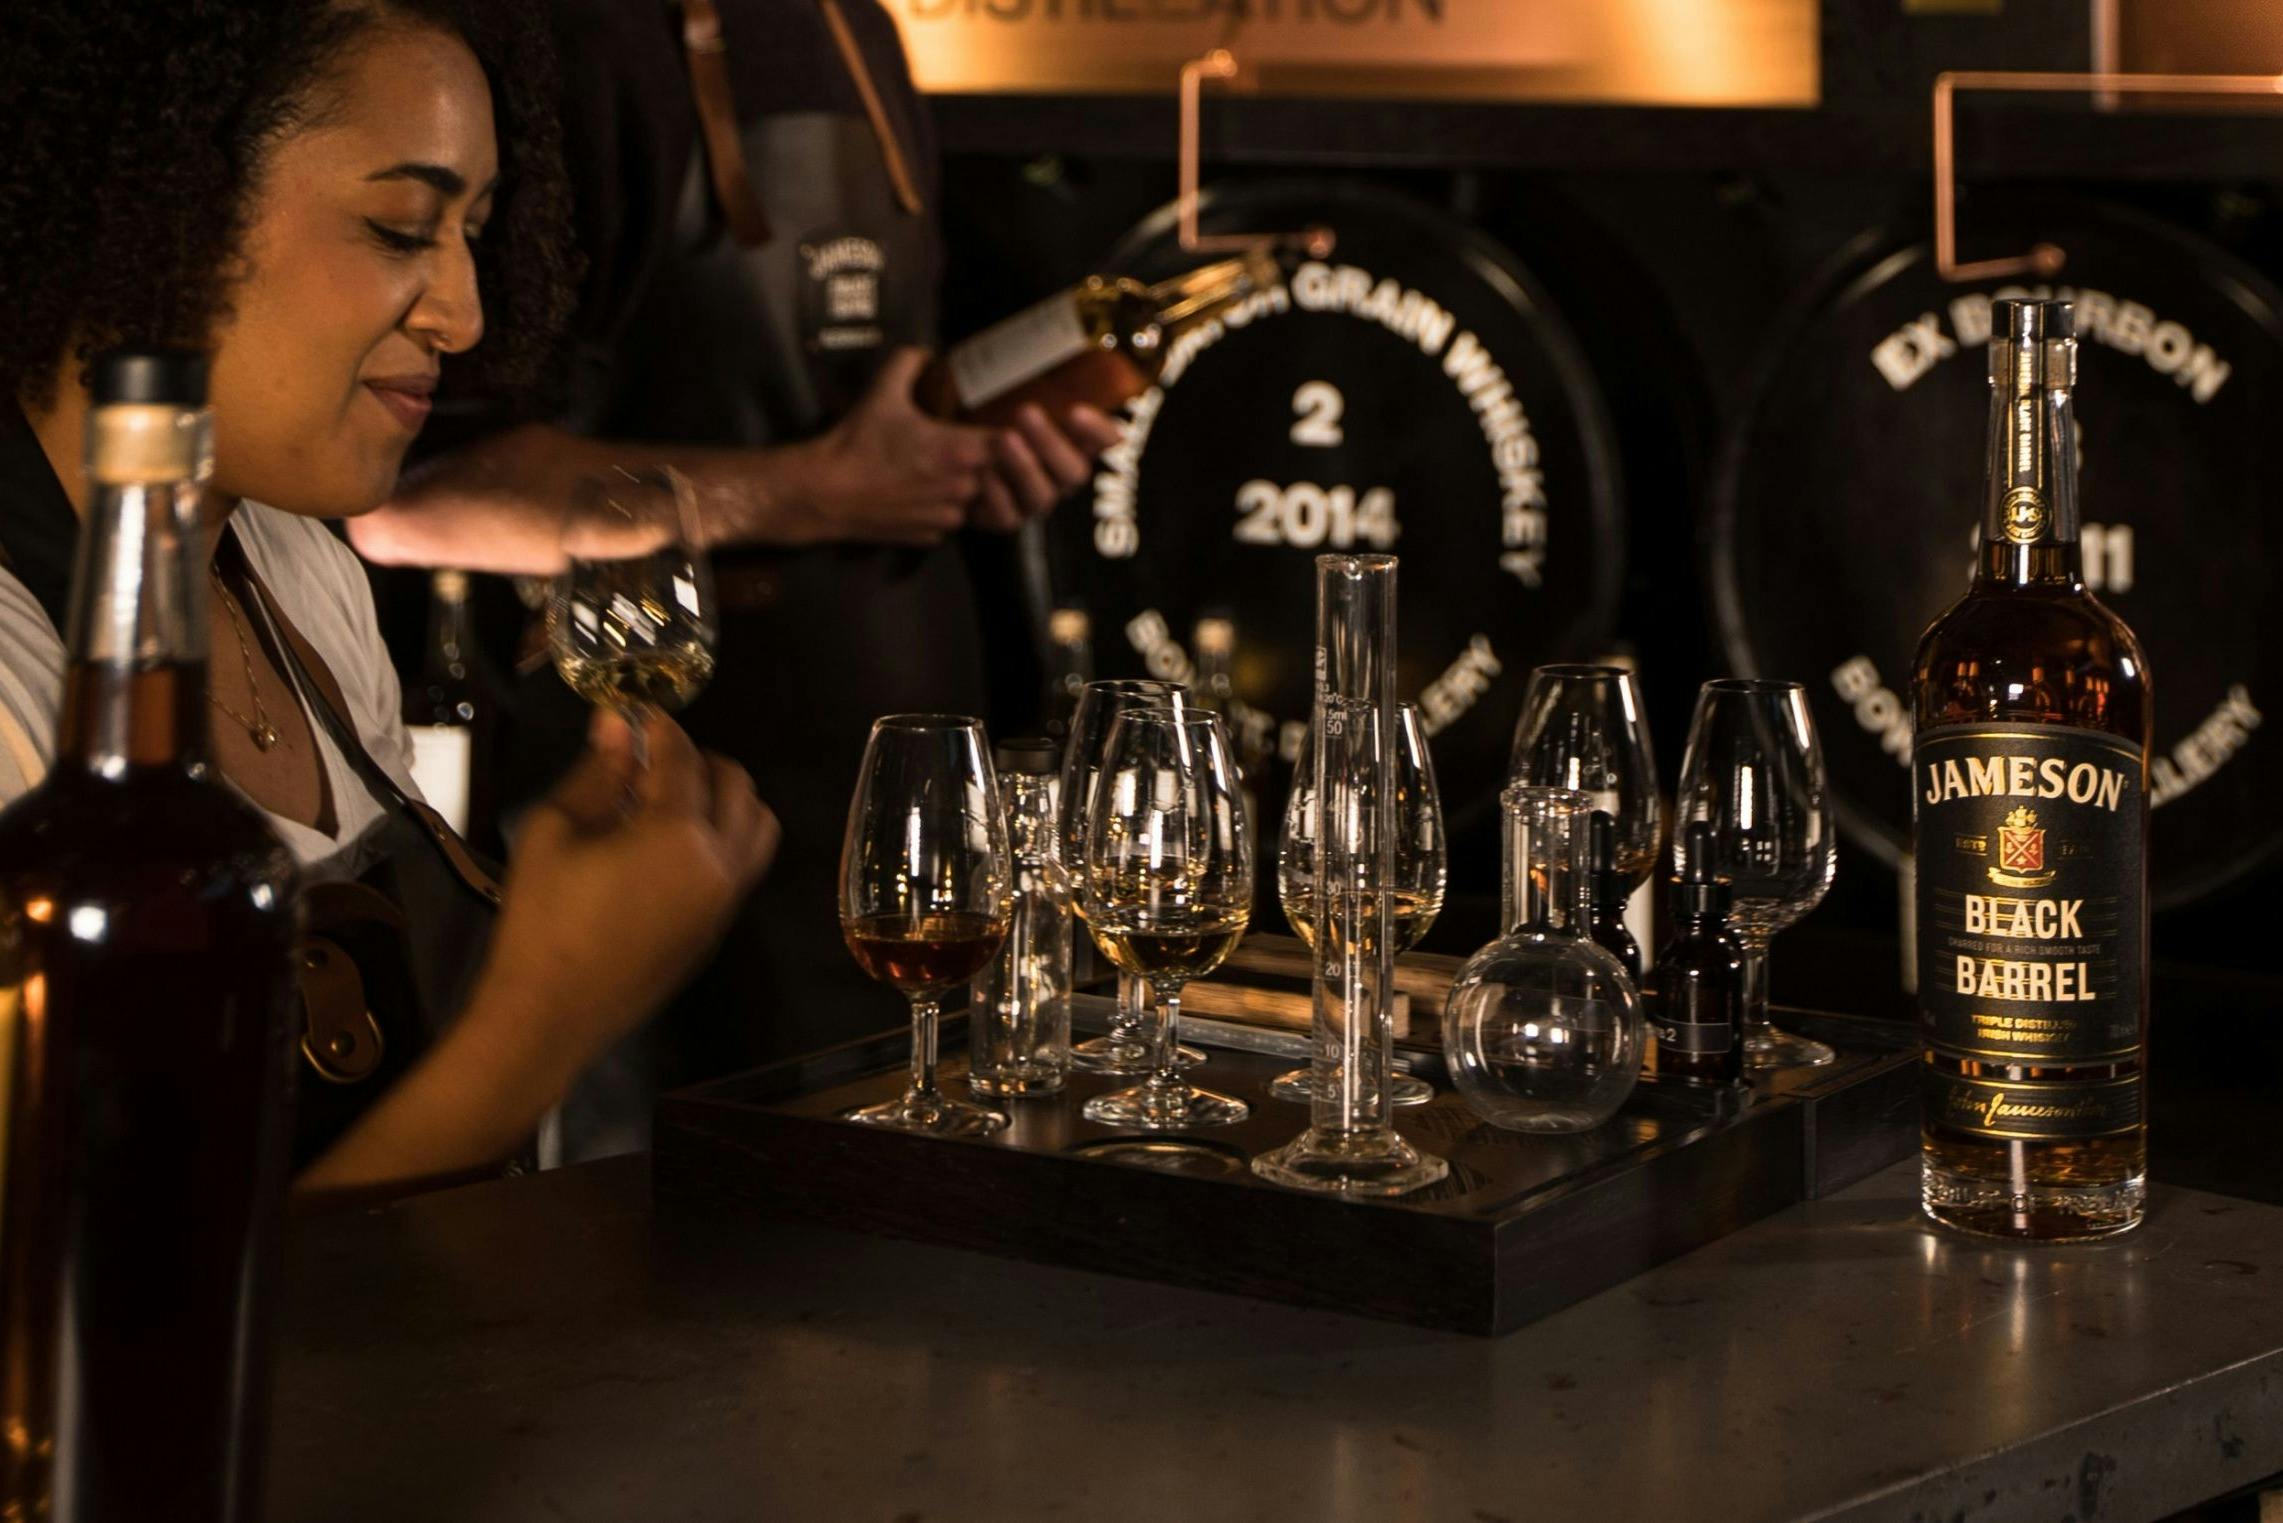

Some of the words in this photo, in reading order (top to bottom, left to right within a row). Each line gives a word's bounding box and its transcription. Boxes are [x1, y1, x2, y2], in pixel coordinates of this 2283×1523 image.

[1870, 310, 1959, 392] EX
[1947, 284, 2234, 405] BRBON
[1289, 380, 1346, 449] 2
[1291, 261, 1456, 356] GRAIN
[1441, 328, 1550, 592] WHISKEY
[1232, 478, 1402, 551] 2014
[1326, 720, 1343, 735] 50
[1926, 755, 2126, 812] JAMESON
[1965, 894, 2084, 940] BLACK
[1325, 962, 1342, 978] 20
[1956, 954, 2097, 1002] BARREL
[1971, 1014, 2014, 1029] TRIPLE
[1325, 1043, 1341, 1059] 10
[1327, 1081, 1337, 1098] 5
